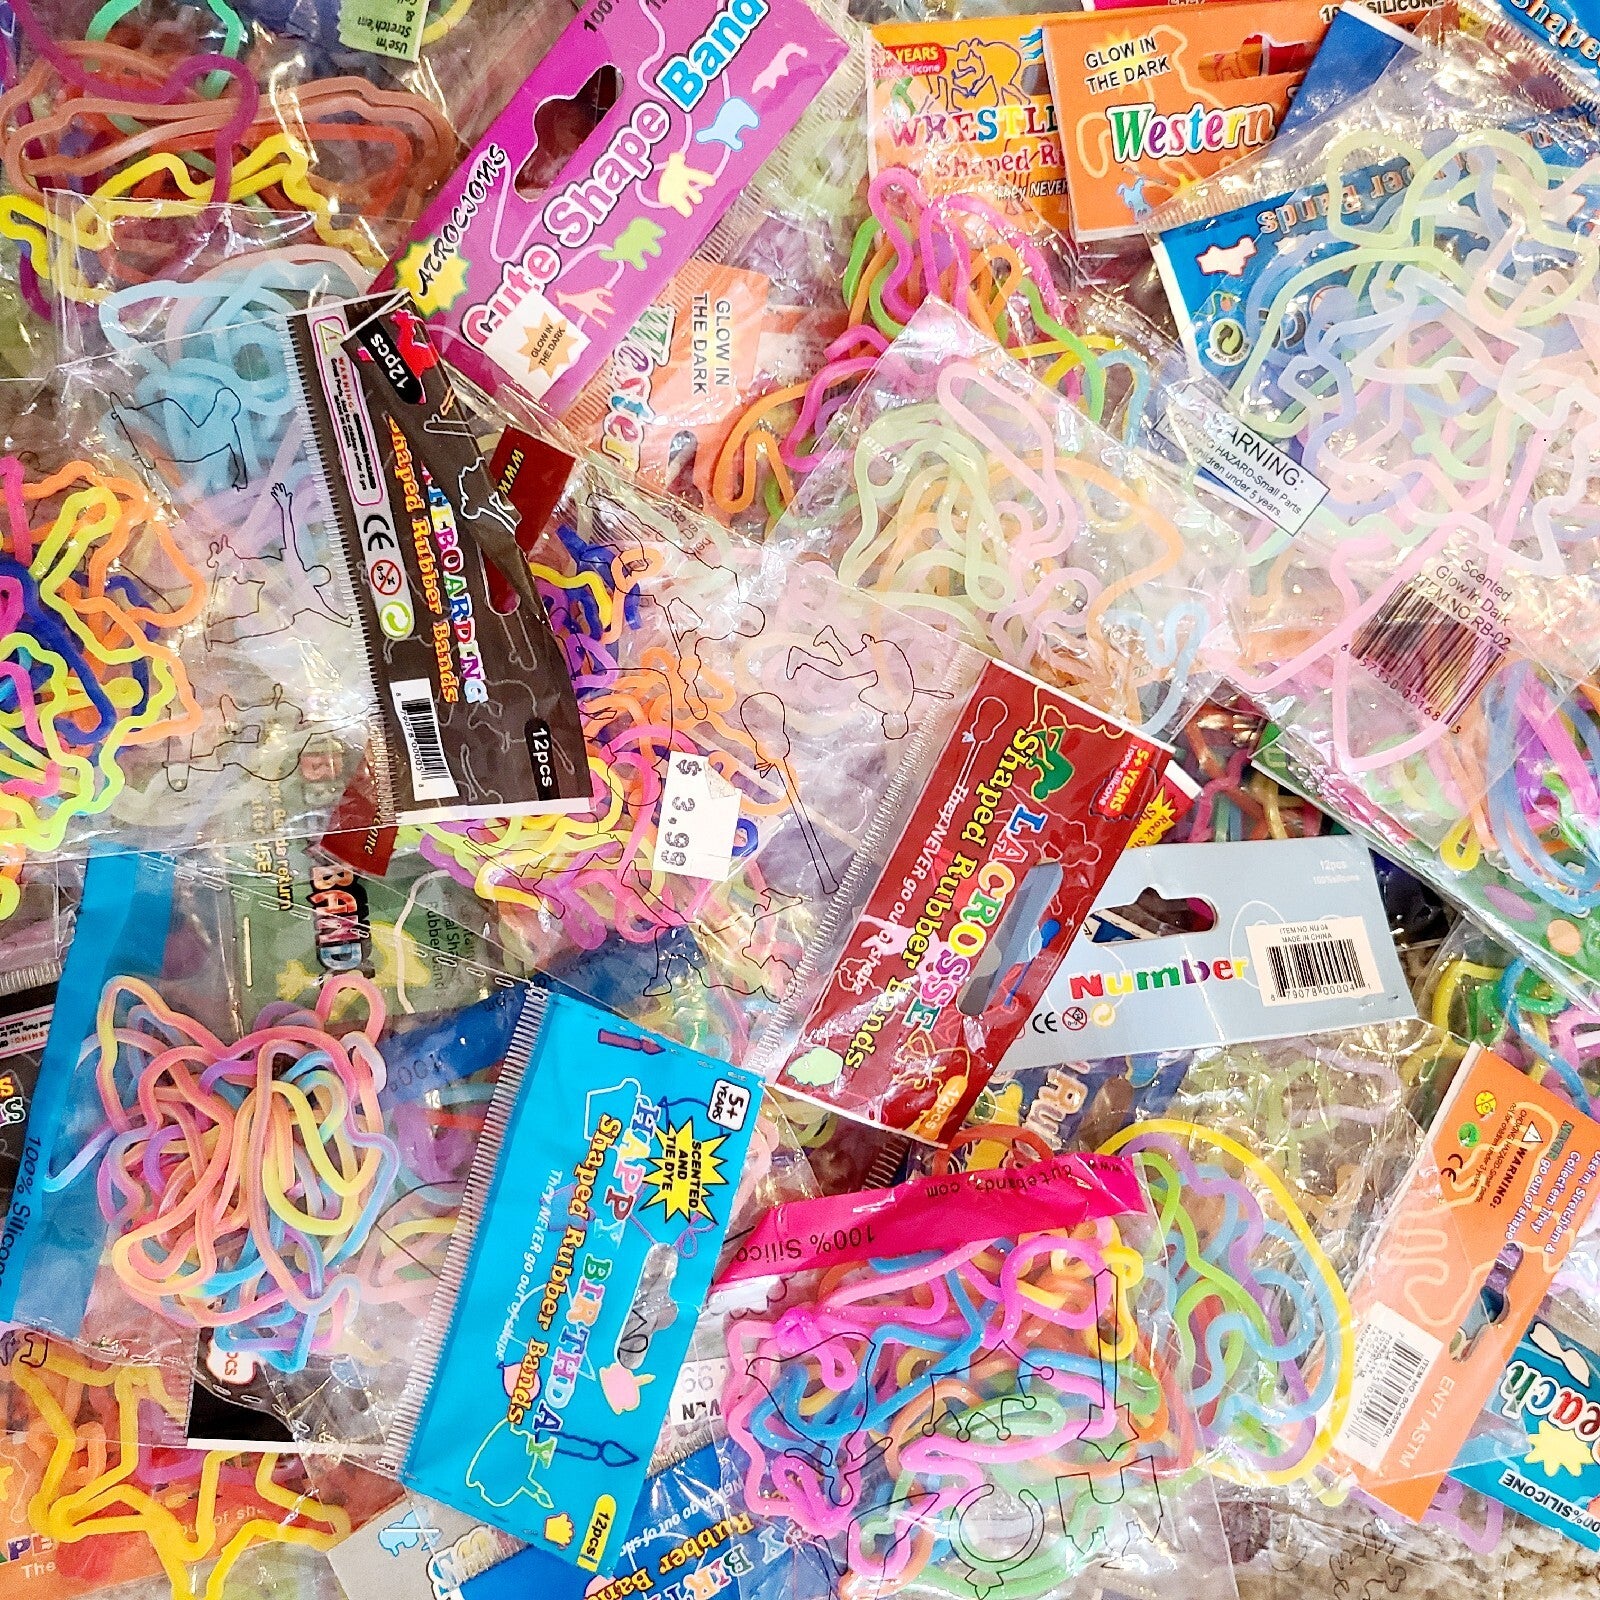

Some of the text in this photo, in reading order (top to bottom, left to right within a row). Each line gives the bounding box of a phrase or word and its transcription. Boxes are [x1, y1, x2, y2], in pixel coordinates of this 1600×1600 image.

[358, 17, 412, 38] Stretch'em
[406, 10, 415, 22] &
[376, 38, 408, 54] Use'm
[660, 0, 766, 108] Band
[896, 46, 939, 63] YEARS
[1086, 36, 1157, 70] GLOW IN
[1087, 56, 1171, 95] THE DARK
[1109, 104, 1276, 161] Western
[547, 103, 668, 244] Shape
[369, 333, 410, 391] 12pcs
[531, 333, 551, 359] GLOW
[538, 327, 567, 367] THE DARK
[692, 293, 708, 395] THE DARK
[716, 300, 731, 386] GLOW IN
[1223, 425, 1307, 491] ARNING:
[1223, 469, 1251, 493] under
[1436, 565, 1472, 600] Glow
[1480, 599, 1512, 627] Dark
[1461, 559, 1512, 603] Scented
[411, 516, 443, 616] Rubber
[432, 619, 460, 704] Bands
[532, 727, 553, 788] 12pcs
[661, 759, 702, 867] $ 3.99
[1108, 769, 1144, 813] YEARS
[910, 822, 948, 881] NEVER
[275, 859, 293, 910] return
[843, 727, 1041, 1070] Shaped Rubber Bands
[900, 876, 918, 902] go
[879, 927, 896, 945] of
[888, 901, 906, 927] out
[902, 802, 1049, 1034] LACROSSE
[1281, 934, 1300, 943] MADE
[1310, 931, 1332, 940] CHINA
[854, 945, 883, 996] shape
[1068, 956, 1248, 1001] Number
[1285, 987, 1317, 1000] 79078
[711, 1085, 730, 1121] YEARS
[726, 1094, 745, 1121] 5+
[924, 1088, 961, 1130] 12pcs
[1506, 1108, 1528, 1141] CHOKING
[1481, 1146, 1495, 1165] under
[1490, 1121, 1508, 1146] children
[15, 1136, 41, 1194] 100%
[661, 1135, 677, 1192] TIE DYE
[676, 1150, 688, 1180] AND
[688, 1140, 702, 1210] SCENTED
[1488, 1146, 1528, 1210] WARNING:
[1527, 1174, 1544, 1195] out
[1535, 1157, 1552, 1175] go
[540, 1168, 563, 1204] They
[1520, 1193, 1536, 1210] of
[1528, 1149, 1583, 1234] Collect'em They
[530, 1203, 555, 1255] NEVER
[1501, 1205, 1528, 1241] shape
[1547, 1185, 1587, 1243] Stretch'em
[808, 1226, 877, 1257] 100%
[1543, 1242, 1556, 1254] &
[506, 1112, 623, 1426] Shaped Rubber Bands
[522, 1254, 539, 1276] go
[526, 1100, 662, 1469] HAPPY BIRTHDAY
[513, 1276, 531, 1303] out
[493, 1315, 520, 1361] shape
[1414, 1358, 1430, 1378] ITEM
[1399, 1374, 1456, 1469] EN71 ASTM
[1503, 1365, 1600, 1438] each
[655, 1512, 683, 1533] out
[1502, 1472, 1600, 1533] 00%SILICONE
[585, 1509, 612, 1558] 12pcs
[658, 1510, 756, 1575] Rubber
